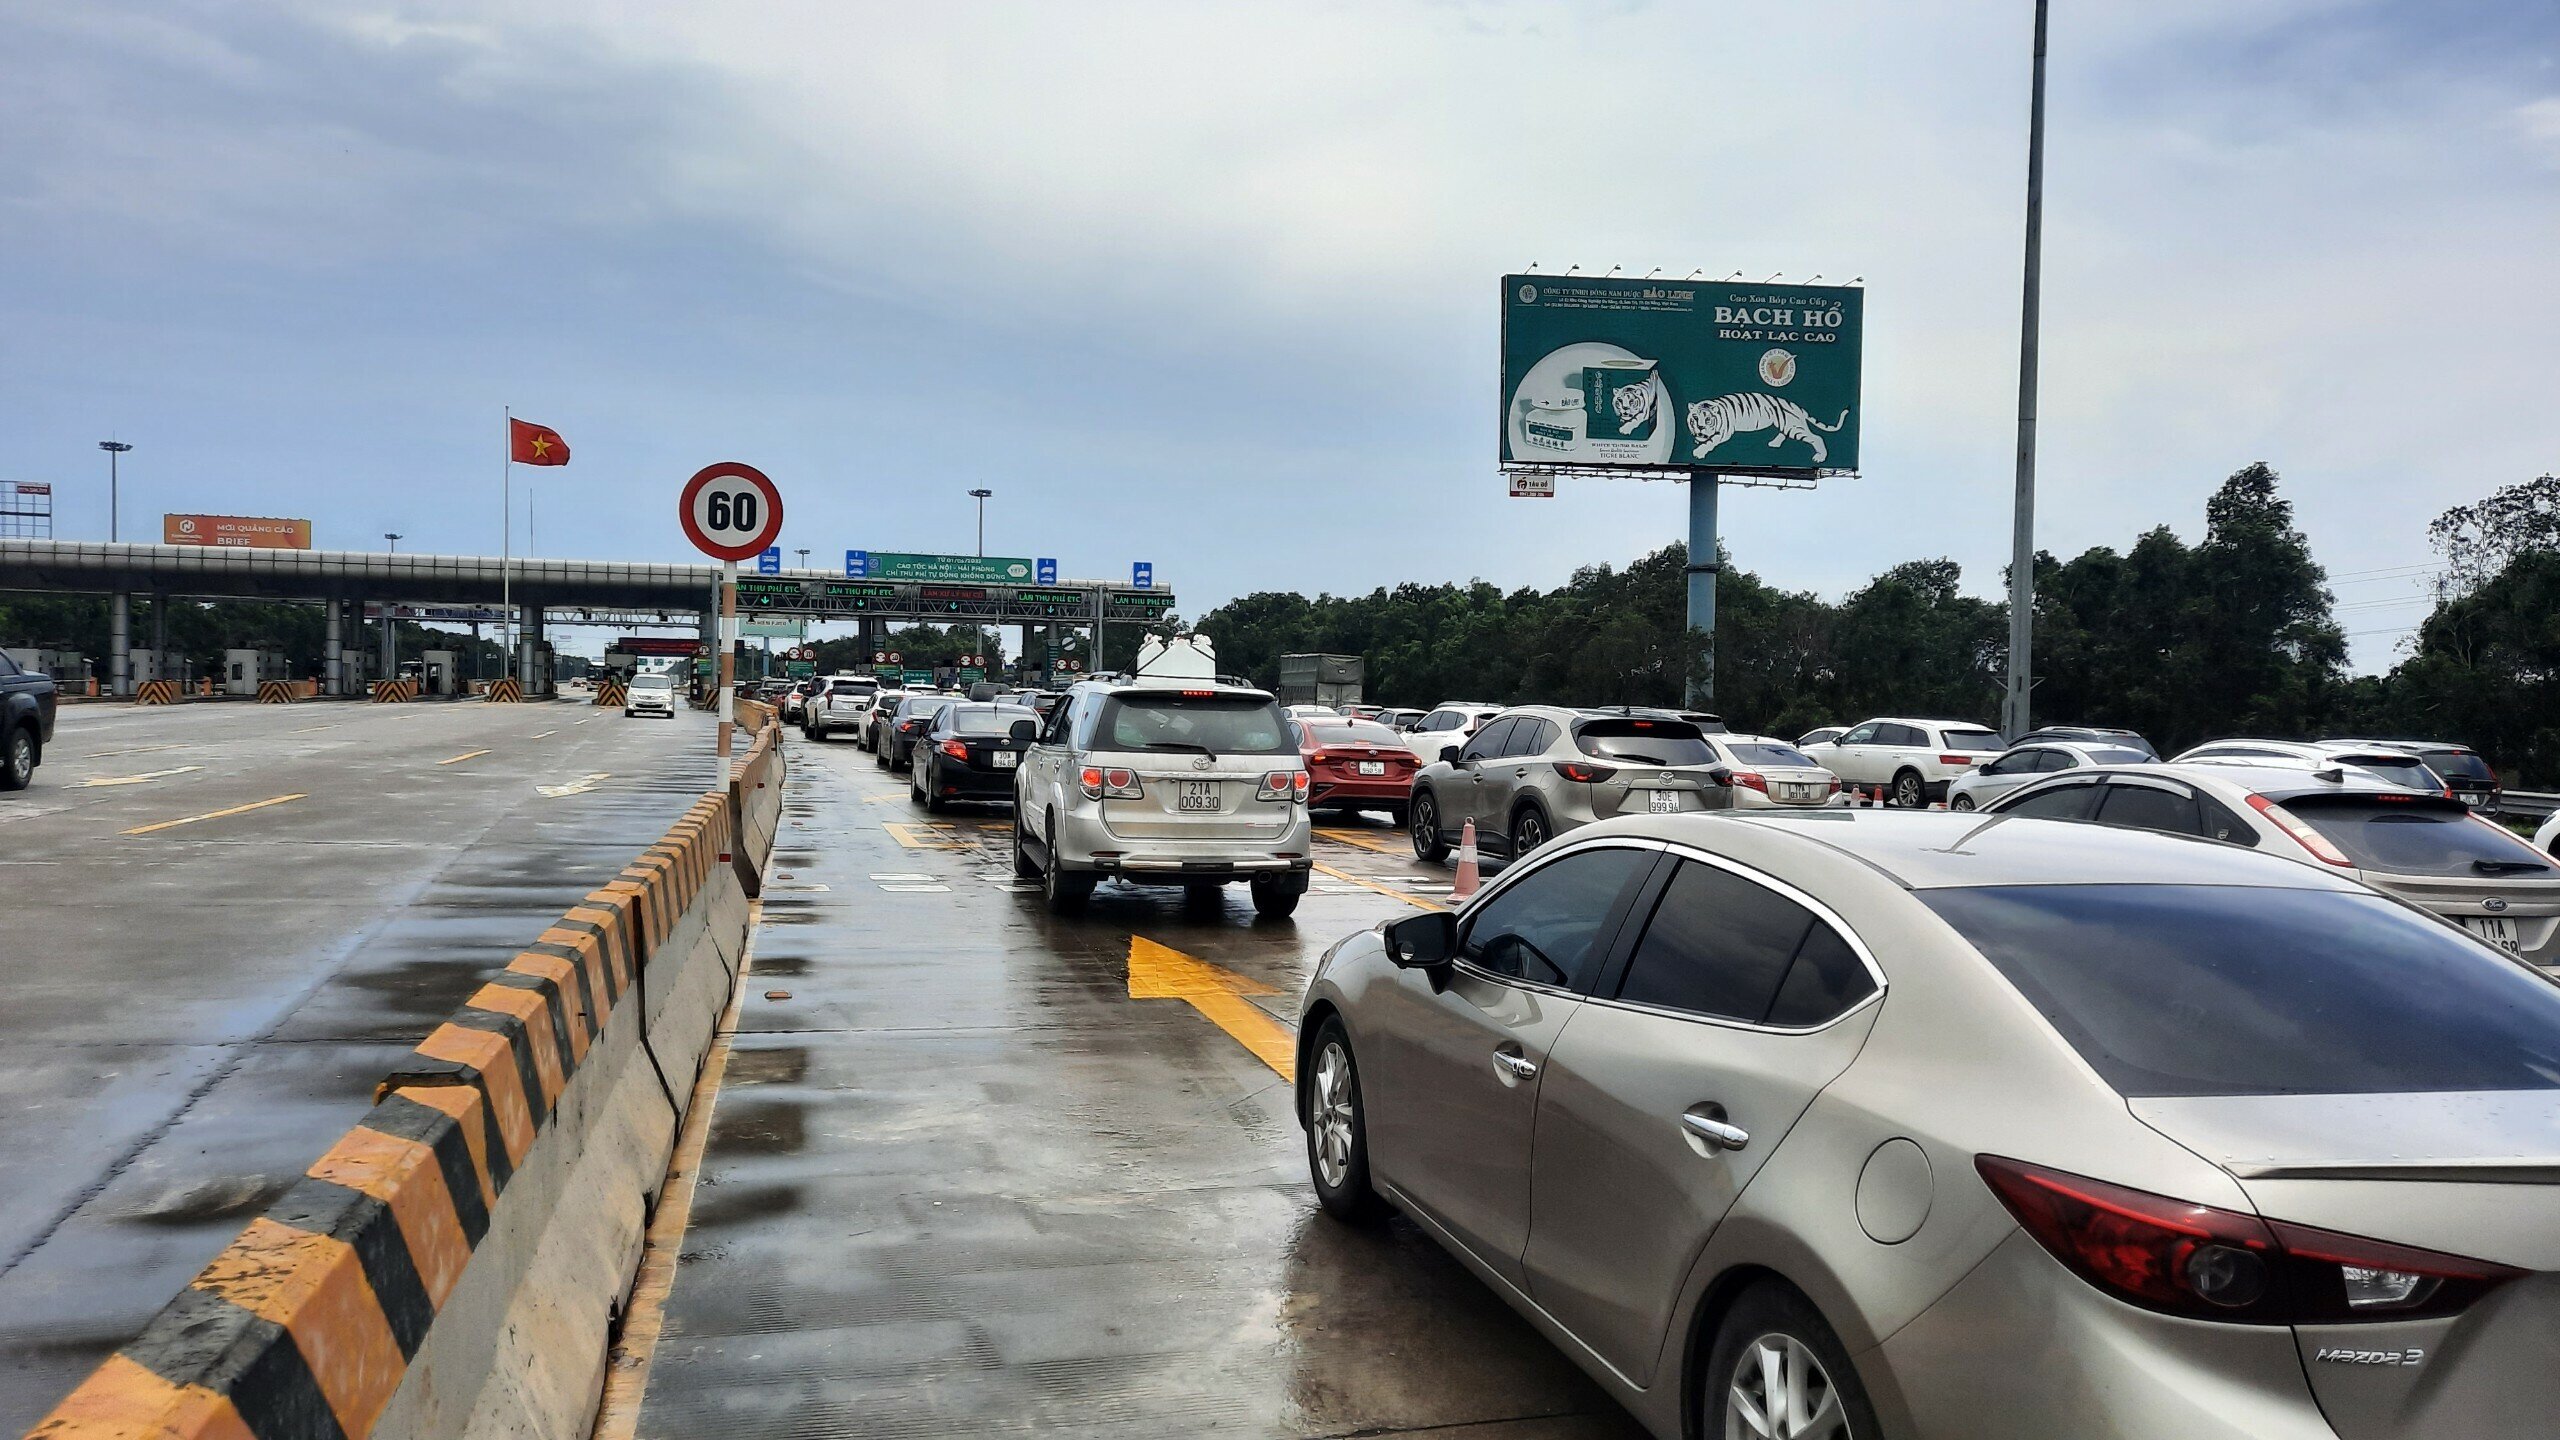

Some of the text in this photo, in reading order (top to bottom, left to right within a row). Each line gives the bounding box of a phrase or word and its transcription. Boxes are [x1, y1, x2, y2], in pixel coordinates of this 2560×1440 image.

[1730, 294, 1747, 302] Cao
[1750, 295, 1766, 303] Xoa
[1769, 296, 1786, 305] Bóp
[1789, 297, 1806, 305] Cao
[1714, 301, 1843, 328] BẠCH HỔ
[1719, 329, 1836, 343] HOẠT LẠC CAO
[708, 491, 757, 532] 60
[217, 537, 251, 546] BRIEF
[1190, 783, 1211, 795] 21A
[1182, 796, 1219, 809] 009.30
[2480, 919, 2506, 939] 11A
